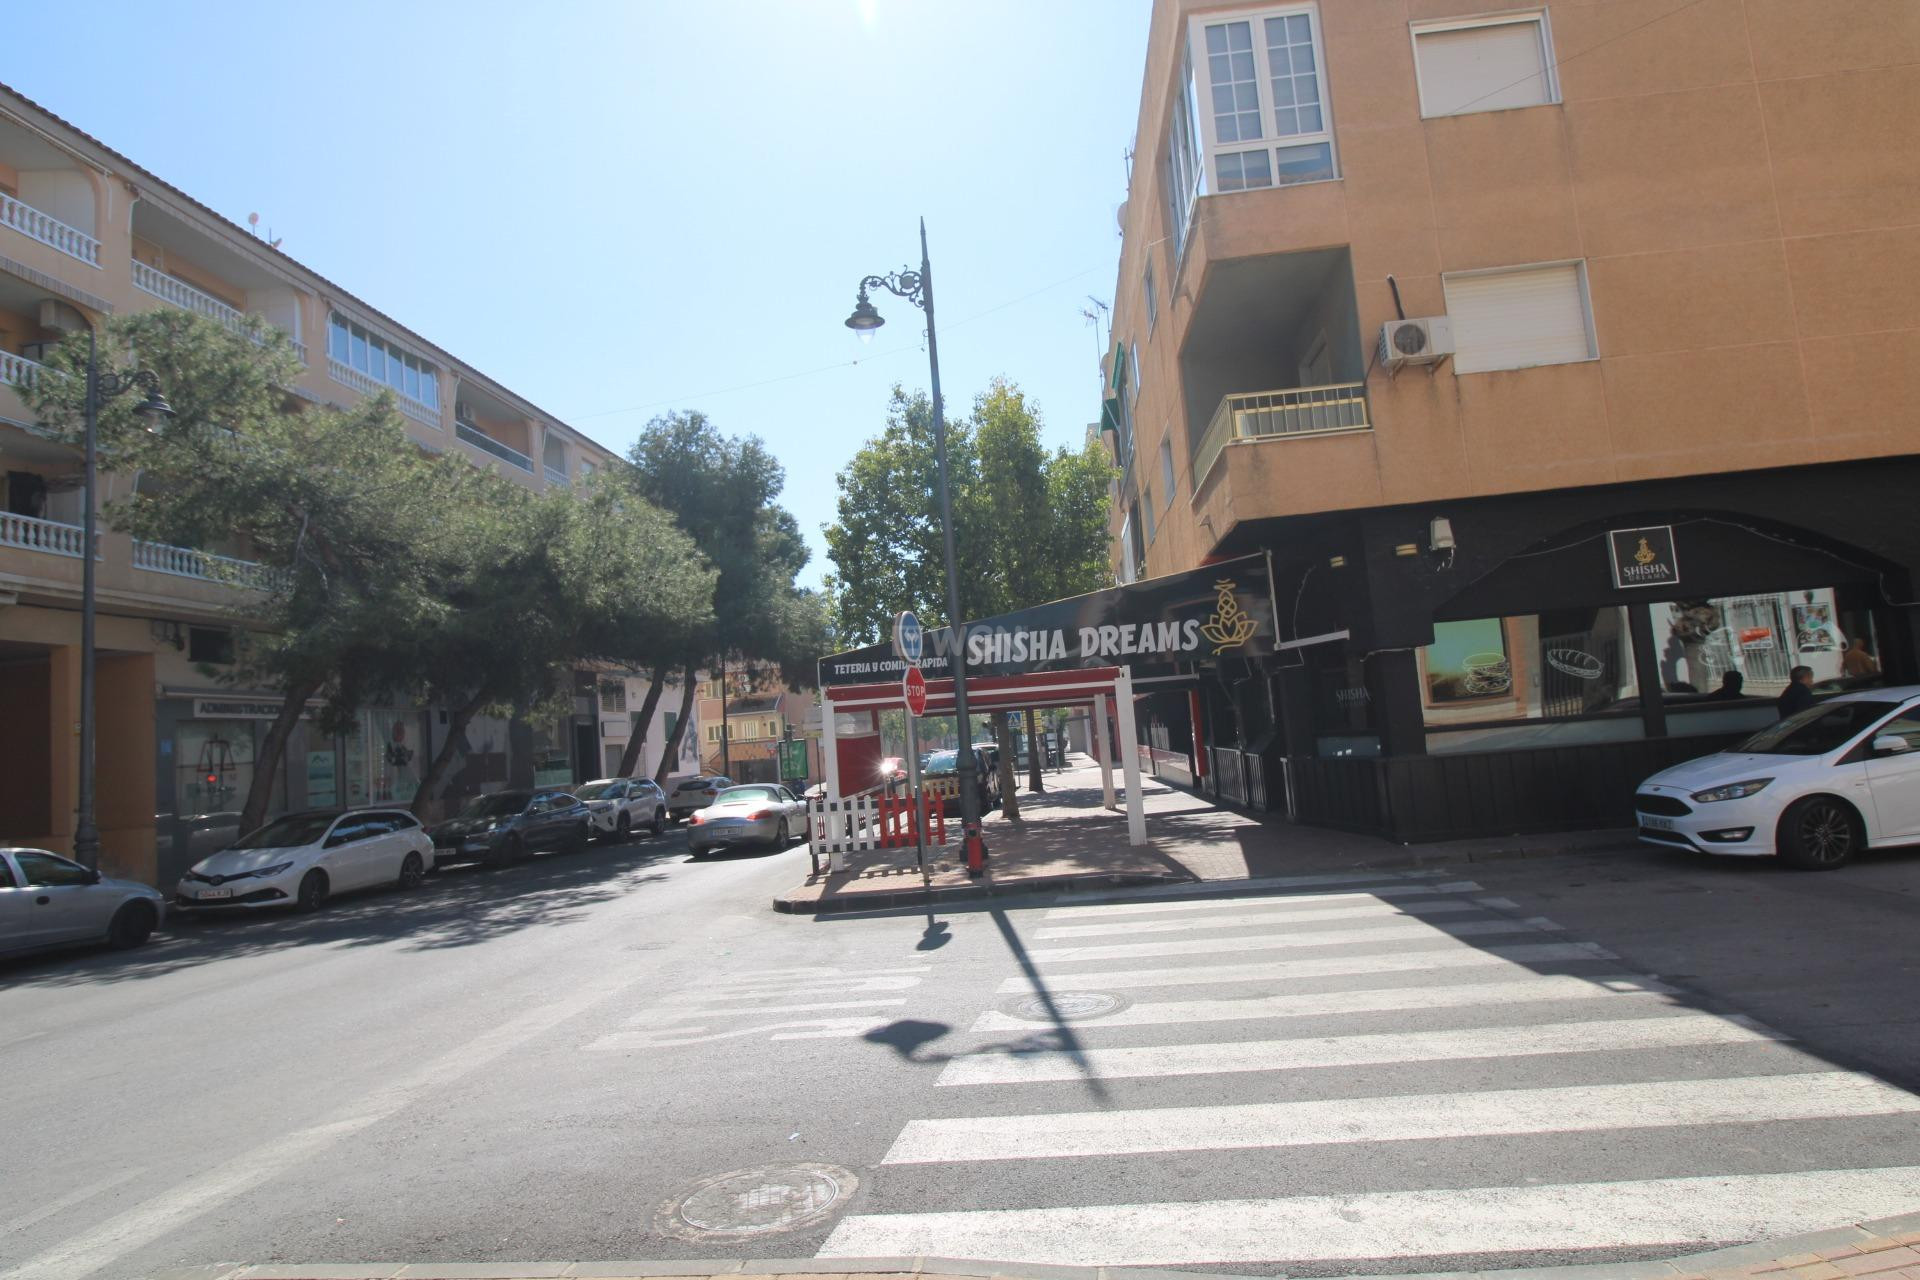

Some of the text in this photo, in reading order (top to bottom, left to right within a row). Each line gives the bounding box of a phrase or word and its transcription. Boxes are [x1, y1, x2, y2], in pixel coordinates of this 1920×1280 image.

[1623, 563, 1670, 577] SHISHA
[966, 619, 1200, 666] SHISHA DREAMS
[834, 662, 871, 675] TETERIA
[879, 660, 907, 673] COMID
[915, 656, 948, 669] RAPIDA
[907, 685, 925, 697] STOP
